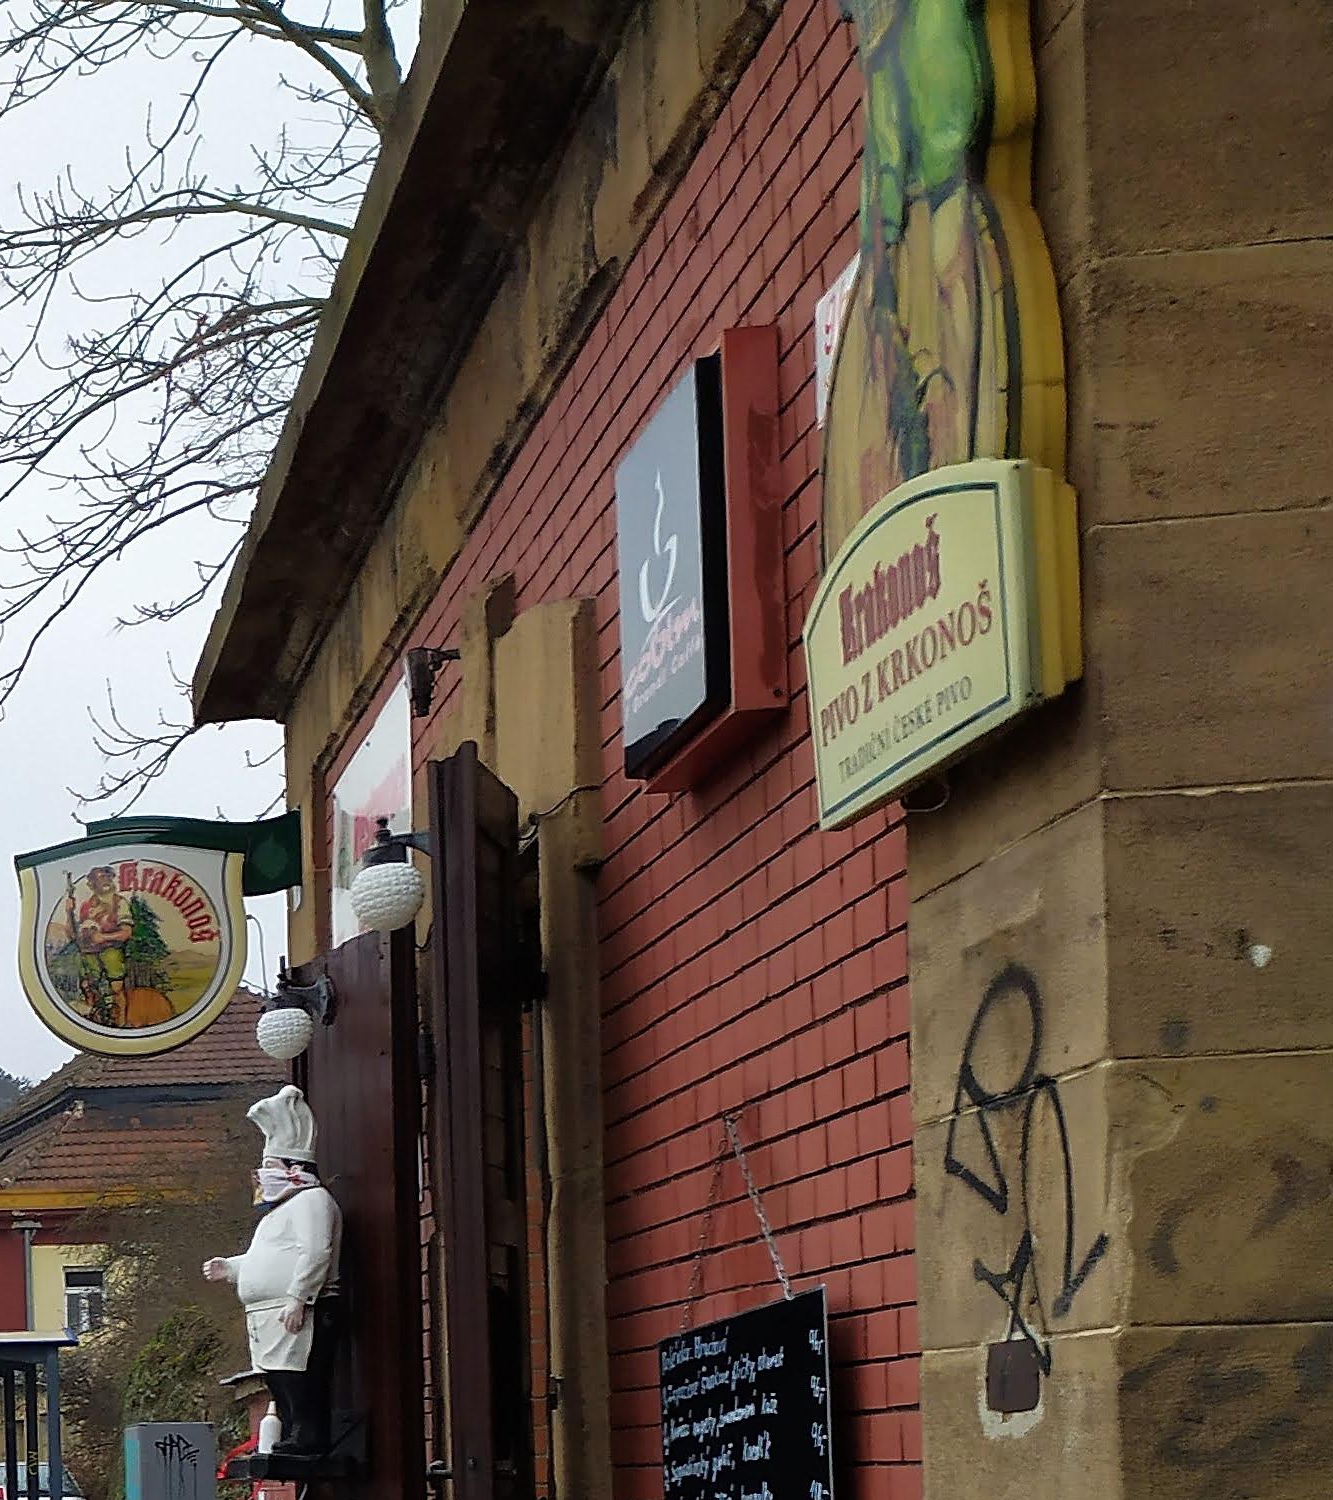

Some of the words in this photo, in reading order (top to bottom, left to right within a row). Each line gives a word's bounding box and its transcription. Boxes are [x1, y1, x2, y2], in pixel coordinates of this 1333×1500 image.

[821, 689, 860, 747] PIVO
[861, 674, 875, 714] Z
[875, 579, 993, 704] KRKONOŠ
[838, 722, 890, 785] TRADIČNÍ
[890, 700, 934, 760] ČESKÉ
[933, 674, 973, 724] PIVO
[118, 861, 221, 944] Krakonoš
